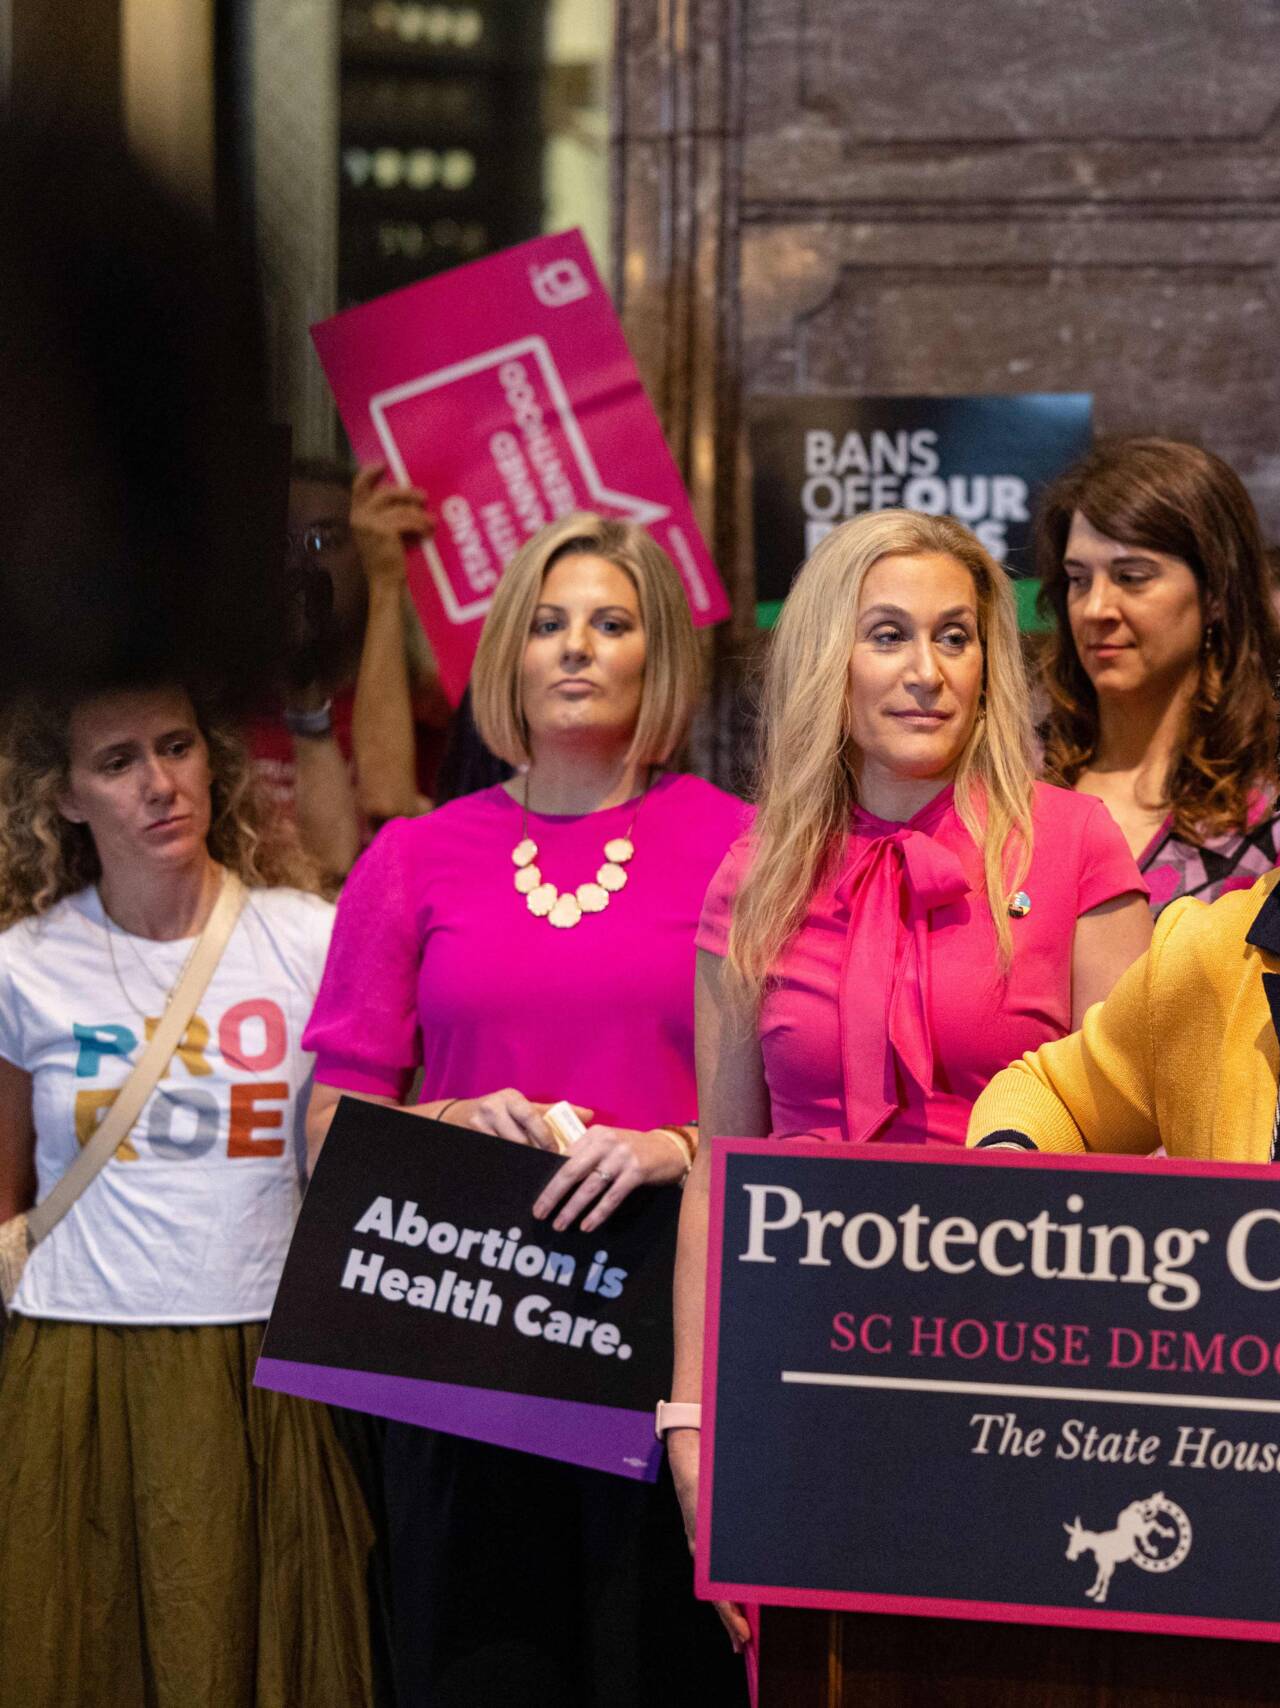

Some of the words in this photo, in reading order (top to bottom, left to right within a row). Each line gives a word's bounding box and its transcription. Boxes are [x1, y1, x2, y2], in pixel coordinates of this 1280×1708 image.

[804, 429, 941, 477] BANS
[802, 475, 900, 520] OFF
[902, 474, 1030, 522] OUR
[73, 998, 288, 1077] PRO
[353, 1195, 576, 1287] Abortion
[583, 1250, 629, 1299] is
[738, 1183, 1210, 1311] Protecting
[340, 1248, 503, 1327] Health
[513, 1294, 633, 1361] Care.
[829, 1311, 894, 1354] SC
[910, 1315, 1090, 1367] HOUSE
[969, 1412, 1046, 1457] The
[1056, 1418, 1161, 1465] State
